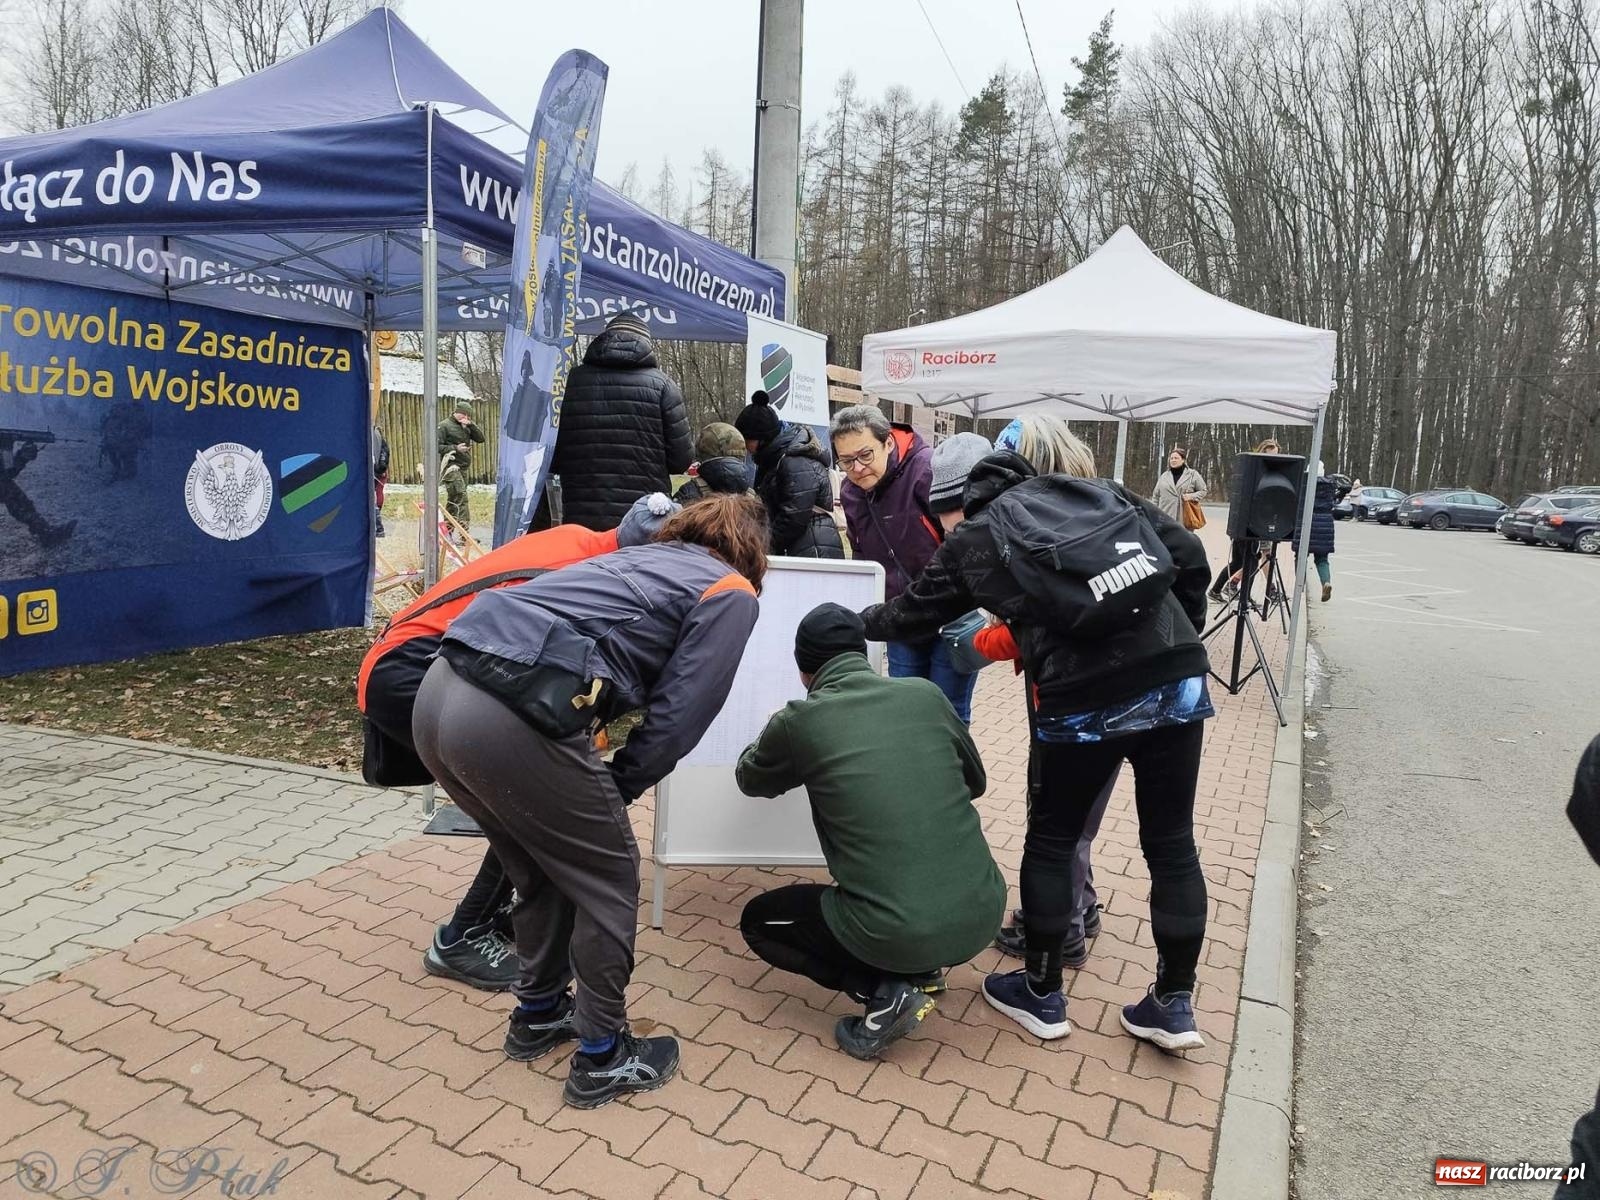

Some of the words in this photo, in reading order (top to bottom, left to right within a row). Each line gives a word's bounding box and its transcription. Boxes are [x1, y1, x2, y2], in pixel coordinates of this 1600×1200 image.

[0, 160, 84, 222] łącz
[96, 149, 155, 205] do
[167, 151, 262, 201] Nas
[176, 320, 351, 372] Zasadnicza
[922, 350, 997, 365] Racibórz
[0, 351, 114, 398] łużba
[127, 365, 300, 412] Wojskowa
[1087, 553, 1158, 602] PUMA
